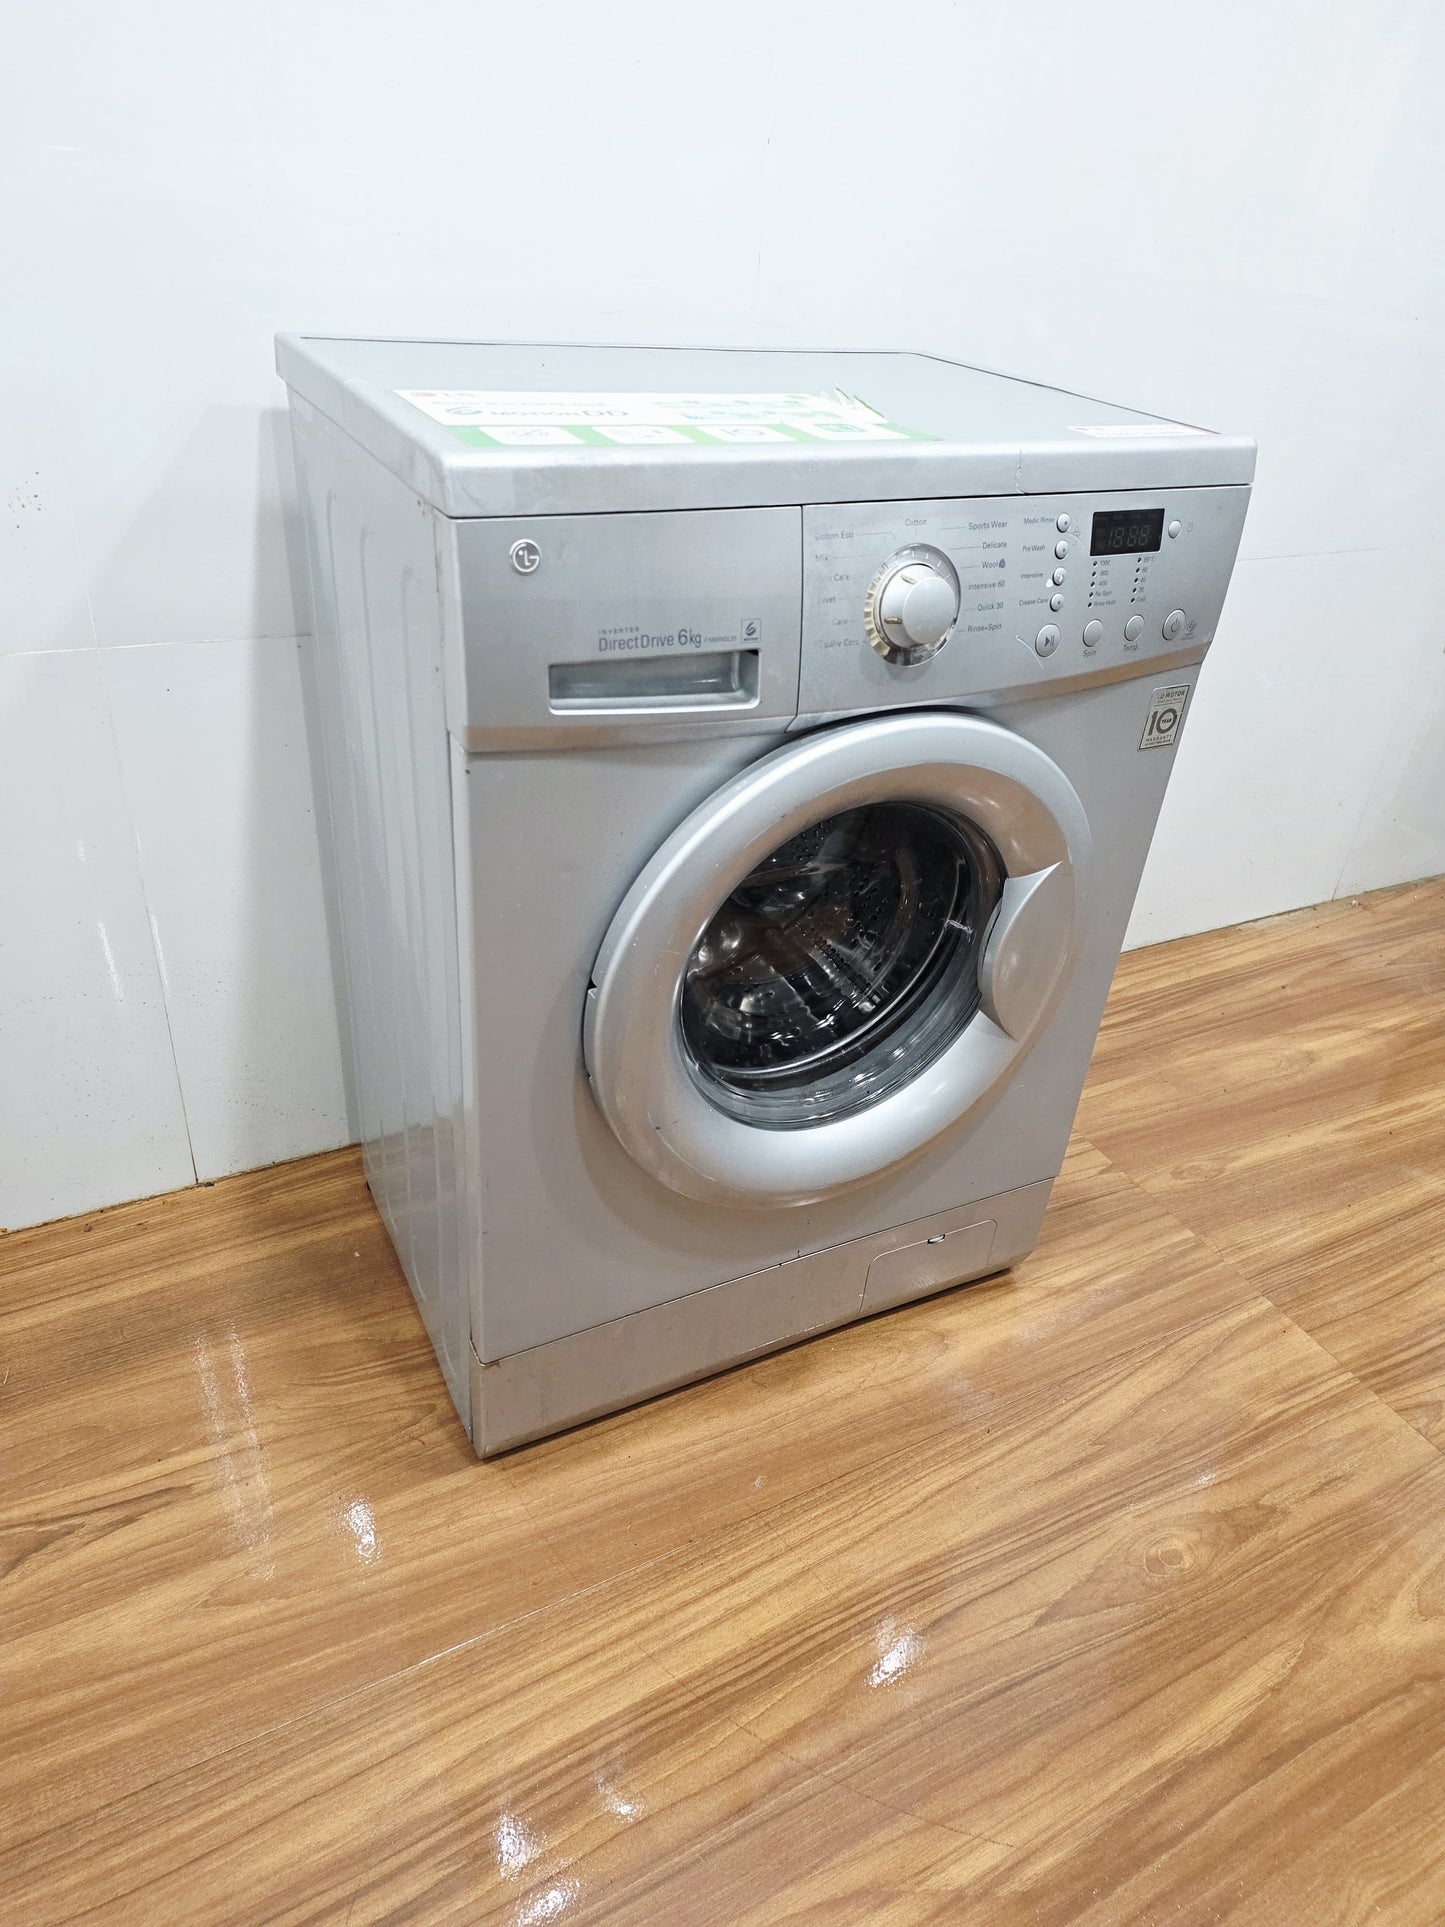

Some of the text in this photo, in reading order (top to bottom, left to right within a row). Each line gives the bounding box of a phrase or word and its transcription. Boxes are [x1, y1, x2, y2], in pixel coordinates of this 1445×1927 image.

[905, 519, 928, 527] Cotton
[968, 520, 1008, 531] Sports Wear
[982, 541, 1008, 550] Delicate
[1031, 544, 1046, 552] Wash
[981, 560, 998, 569] Wool
[968, 580, 1006, 591] Intensive 60
[977, 601, 1004, 612] Quick 30
[967, 622, 1002, 633] Rinse+Spin
[678, 628, 702, 649] 6kg
[1148, 708, 1178, 736] 10
